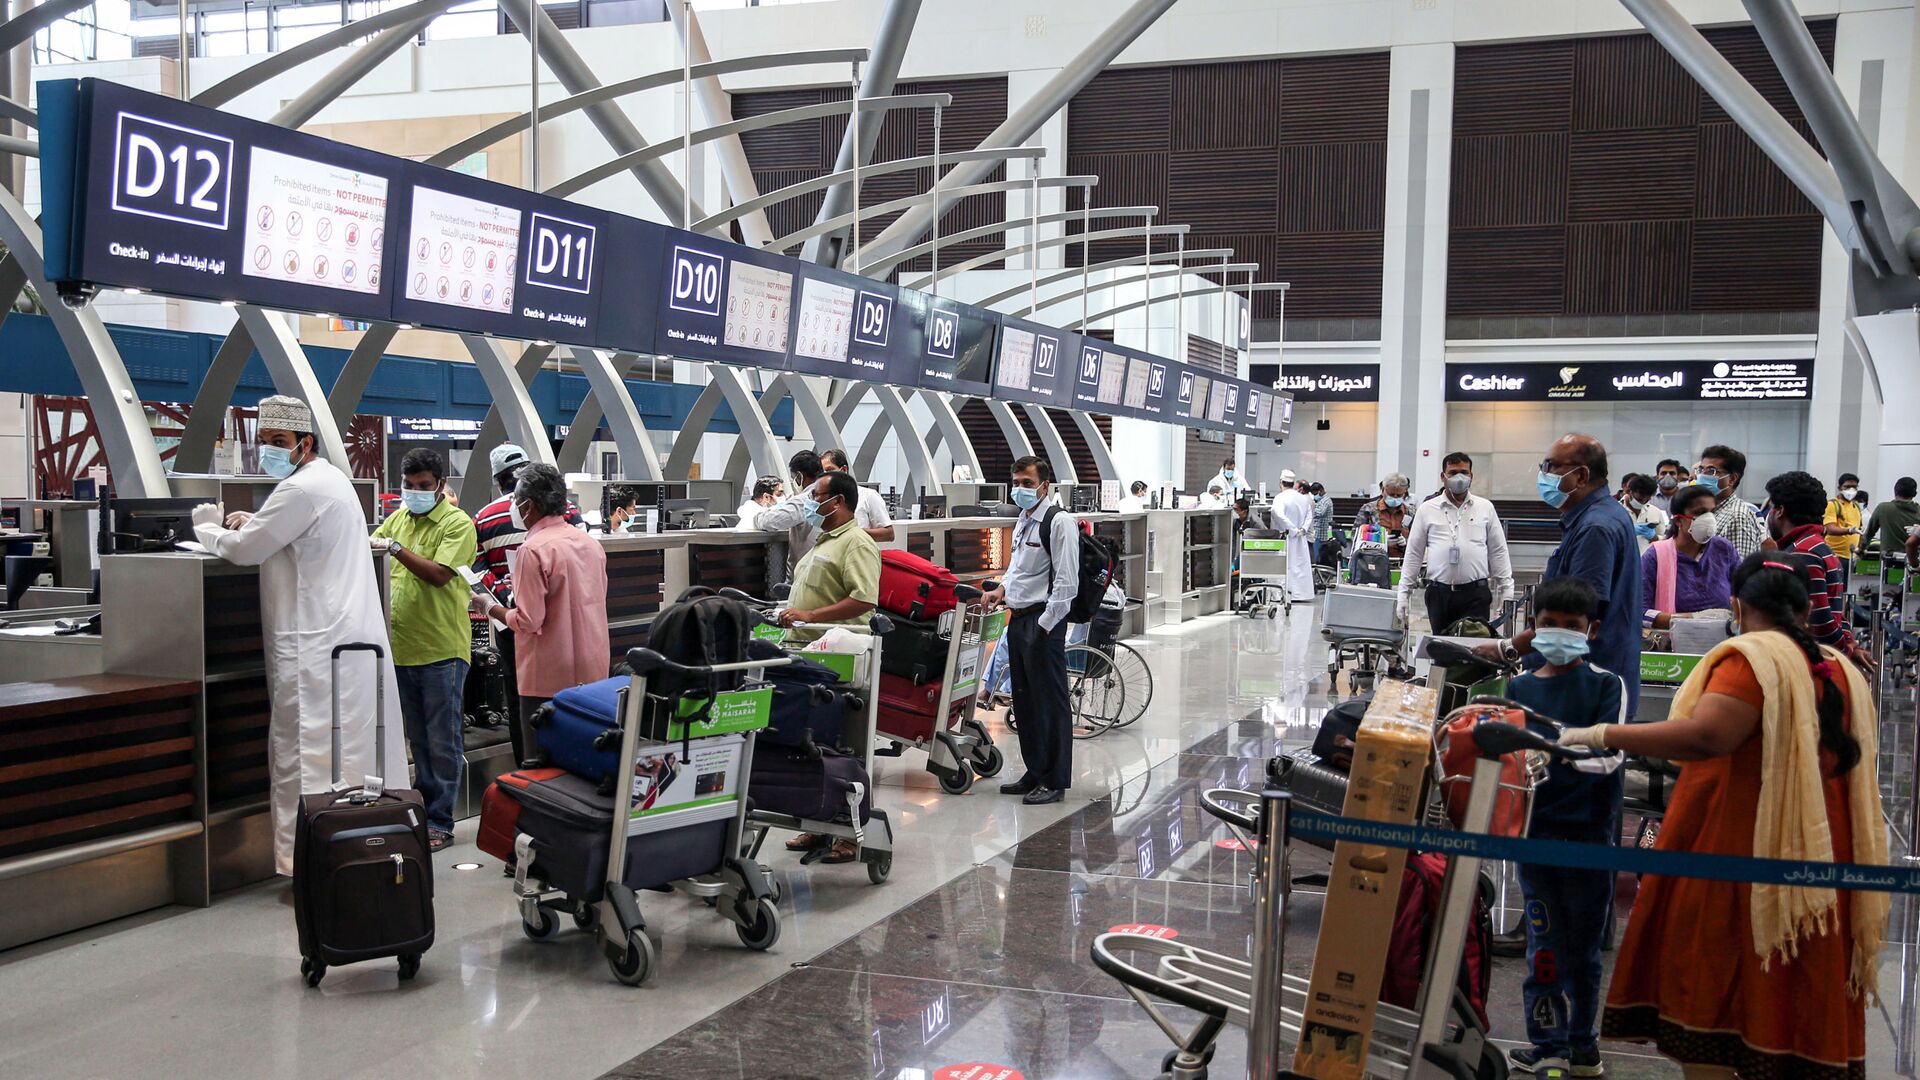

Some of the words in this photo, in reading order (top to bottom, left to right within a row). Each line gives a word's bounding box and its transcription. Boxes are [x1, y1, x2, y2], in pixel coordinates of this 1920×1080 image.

[126, 133, 221, 212] D12
[273, 175, 311, 192] Prohibited
[311, 183, 331, 197] items
[336, 189, 353, 201] NOT
[430, 210, 460, 225] Prohibited
[460, 217, 475, 228] items
[479, 221, 492, 231] NOT
[109, 242, 149, 260] Check-in
[155, 252, 179, 265] السفر
[536, 227, 586, 280] D11
[180, 255, 207, 272] إجراءات
[208, 260, 225, 275] إنهاء
[675, 258, 718, 304] D10
[862, 301, 884, 337] D9
[933, 316, 952, 350] D8
[1039, 342, 1054, 369] D7
[1083, 353, 1096, 379] D6
[1151, 369, 1163, 392] D5
[1180, 377, 1190, 397] D4
[1318, 375, 1371, 392] الحجوزات
[1460, 374, 1525, 391] Cashier
[1612, 372, 1683, 391] المحاسب
[721, 708, 756, 718] MAISARAH
[1316, 817, 1416, 843] International
[1420, 832, 1477, 851] Airport
[1783, 865, 1836, 883] الدولي
[1841, 867, 1896, 885] مسقط
[1526, 899, 1550, 936] 9
[1535, 950, 1557, 984] 6
[1533, 995, 1557, 1029] 4
